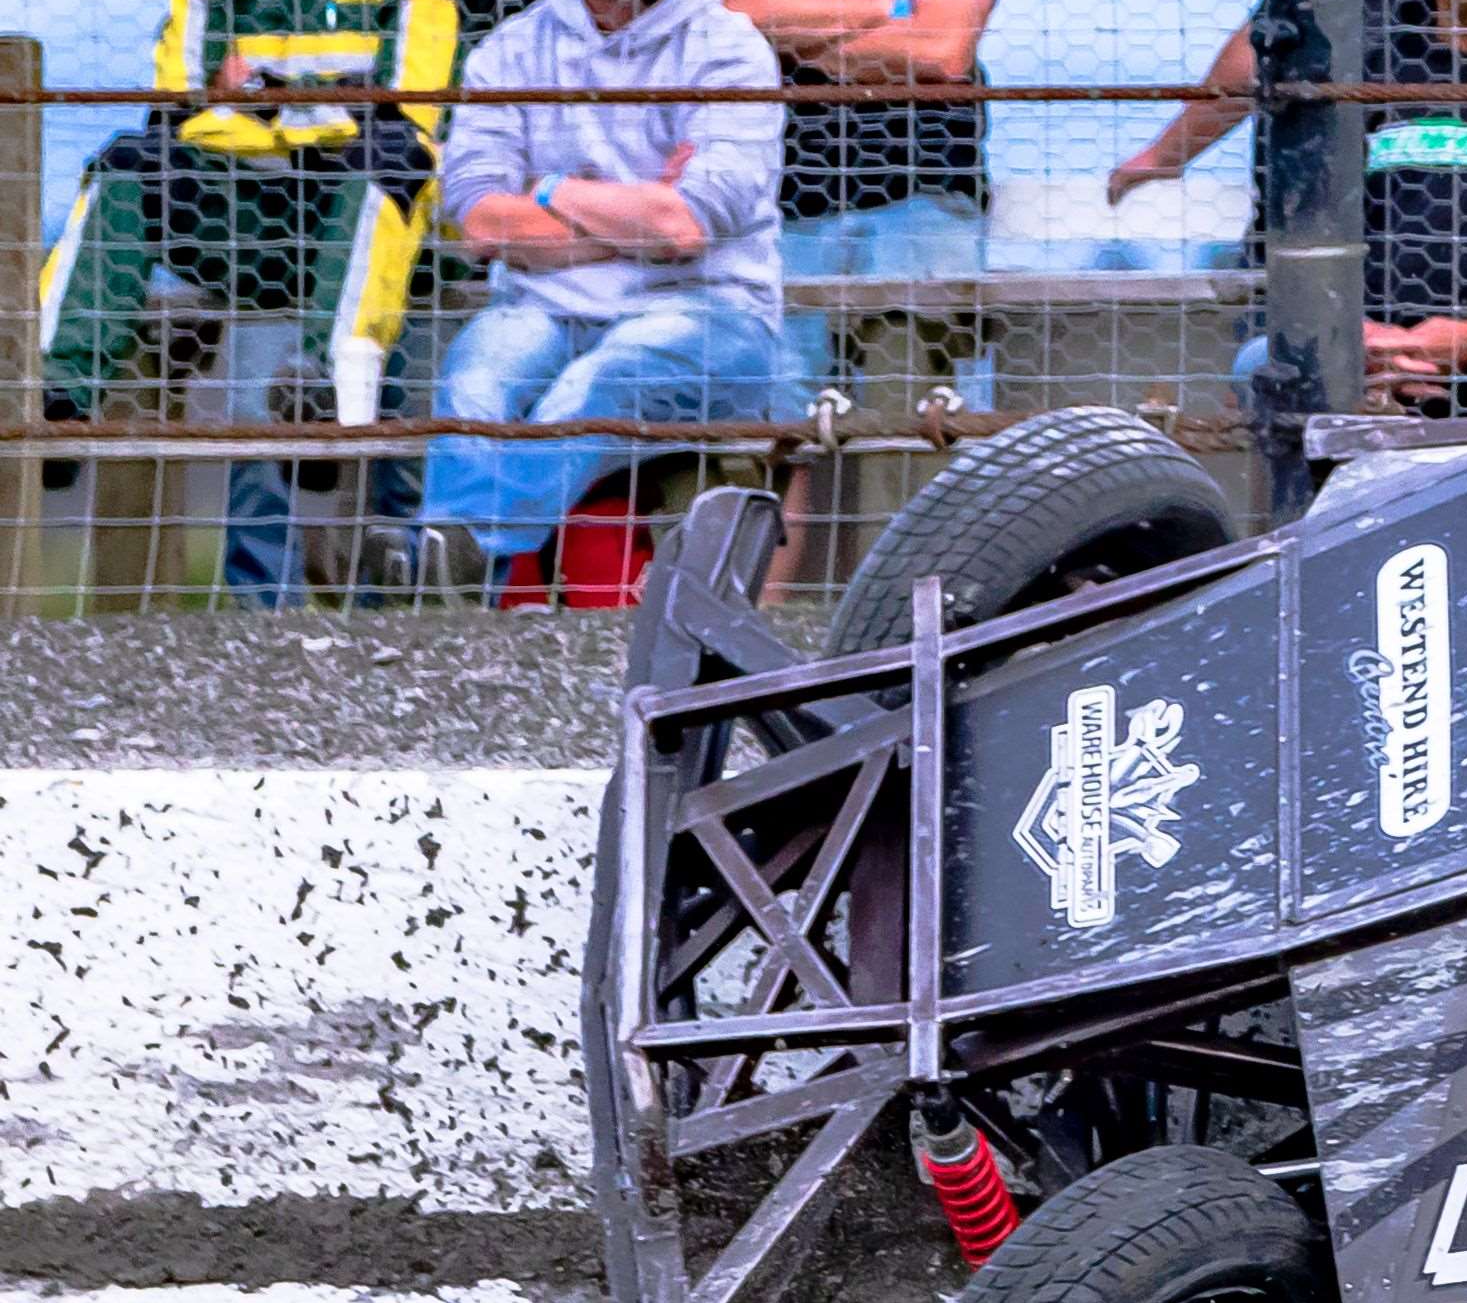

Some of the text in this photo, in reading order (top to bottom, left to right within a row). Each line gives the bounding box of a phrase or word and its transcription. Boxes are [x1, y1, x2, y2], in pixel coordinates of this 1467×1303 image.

[1080, 700, 1104, 837] WAREHOUSE
[1400, 558, 1429, 824] WESTEND HIRE
